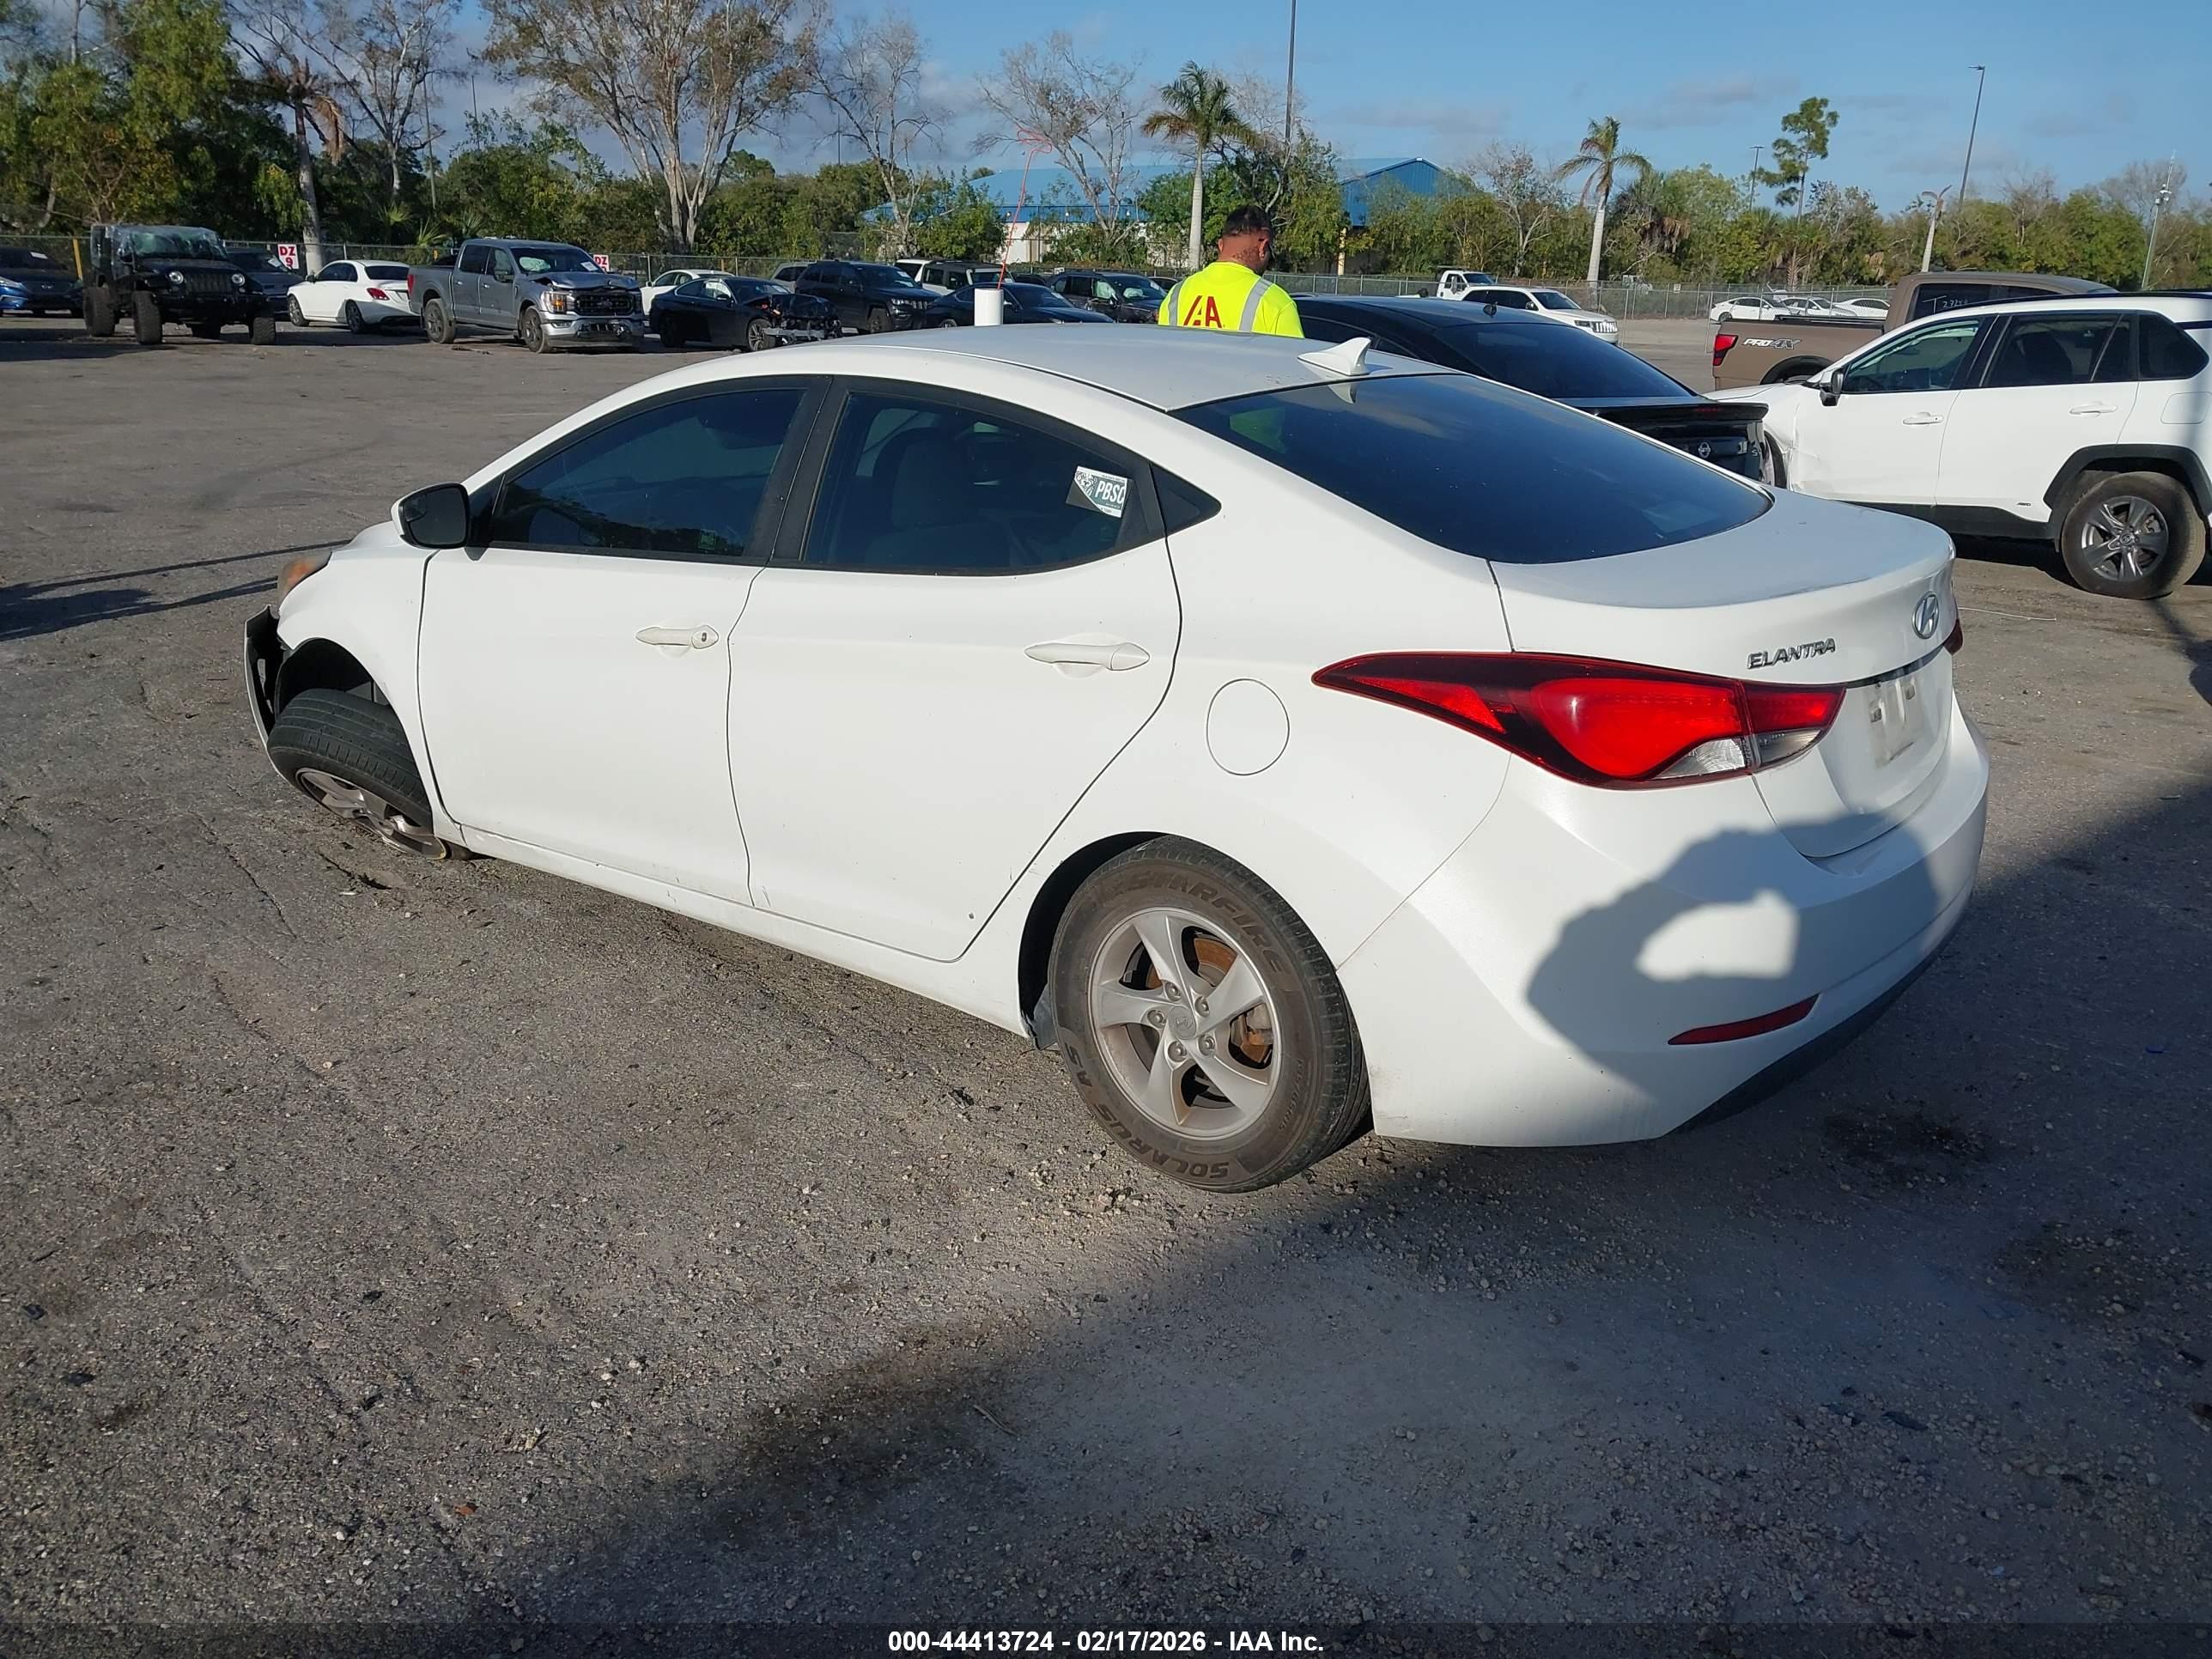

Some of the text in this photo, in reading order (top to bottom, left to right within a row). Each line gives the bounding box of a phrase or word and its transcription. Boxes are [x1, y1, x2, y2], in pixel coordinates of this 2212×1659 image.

[279, 246, 296, 256] DZ
[1747, 638, 1836, 670] ELANTRA
[1065, 1042, 1230, 1179] SOLARUS AS
